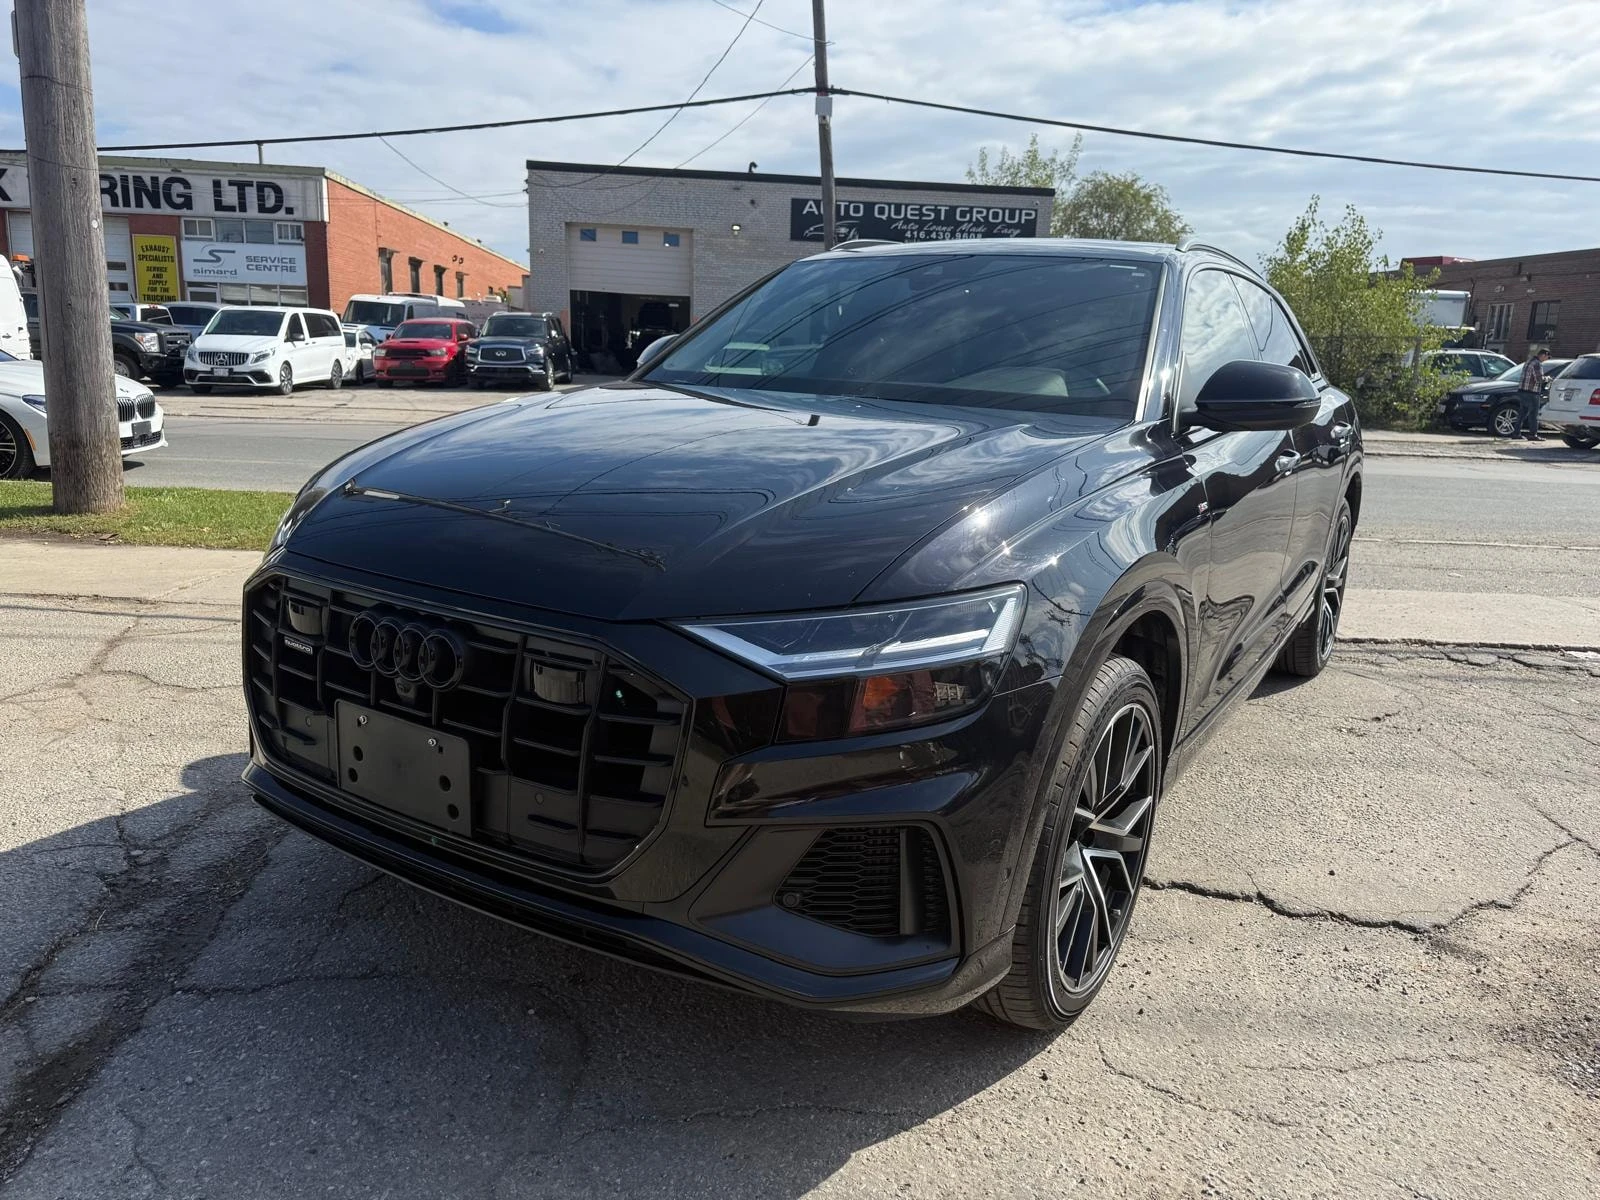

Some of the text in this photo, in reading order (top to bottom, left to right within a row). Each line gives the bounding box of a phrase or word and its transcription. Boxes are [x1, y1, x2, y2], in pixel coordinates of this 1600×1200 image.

[212, 179, 295, 215] LTD.
[802, 200, 1036, 224] ATO QUEST GROUP
[140, 244, 170, 254] EXHAUST
[138, 254, 174, 263] SPECIALISTS
[245, 255, 297, 265] SERVICE
[193, 267, 238, 276] simard
[246, 264, 297, 273] CENTRE
[142, 294, 177, 302] TRUCKING
